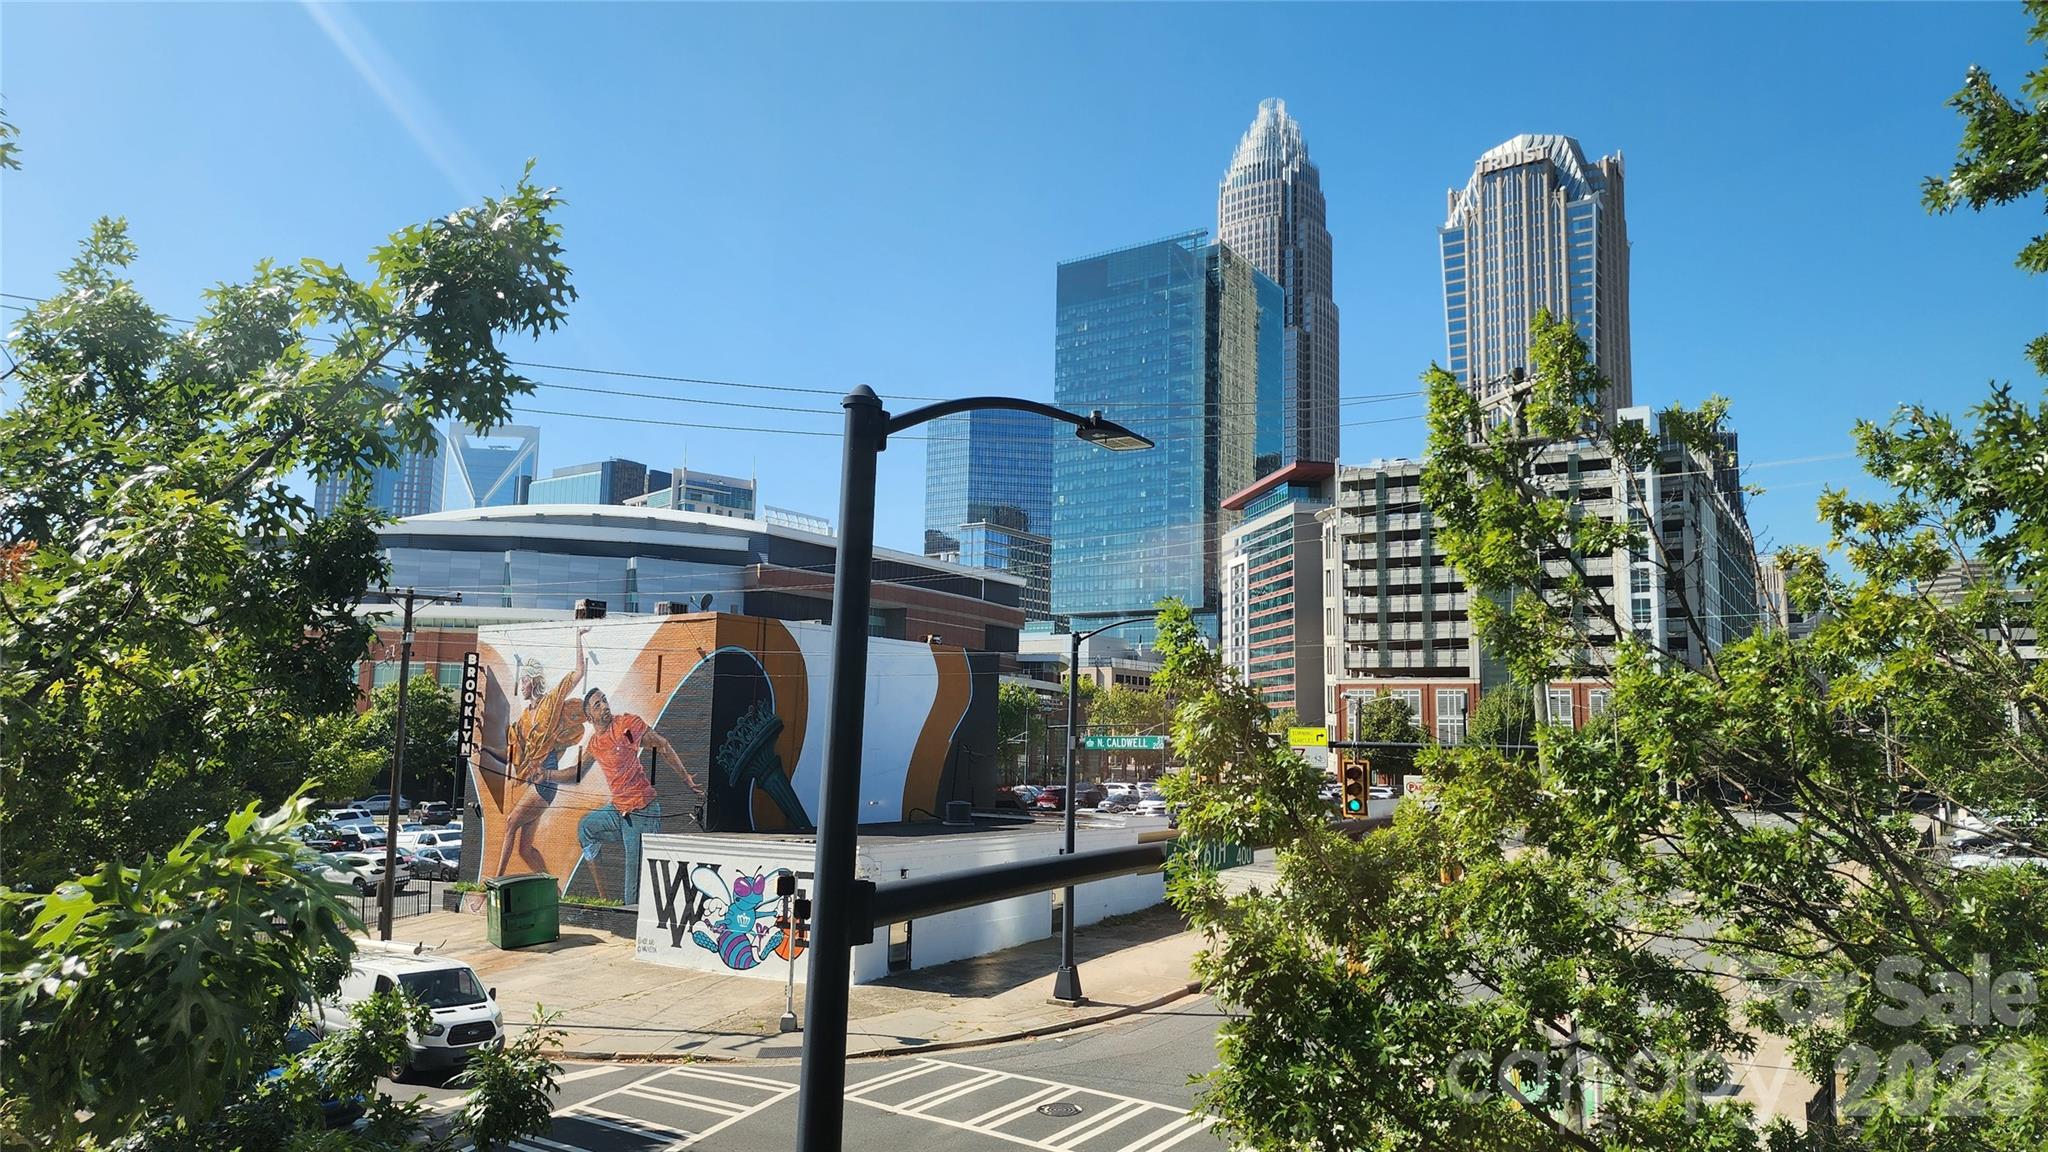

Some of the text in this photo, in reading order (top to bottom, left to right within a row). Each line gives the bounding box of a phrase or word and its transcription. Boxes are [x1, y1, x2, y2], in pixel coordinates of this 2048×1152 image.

[1475, 147, 1549, 174] TRUIST
[461, 653, 478, 754] BROOKLYN
[1097, 737, 1149, 748] N. CALDWELL
